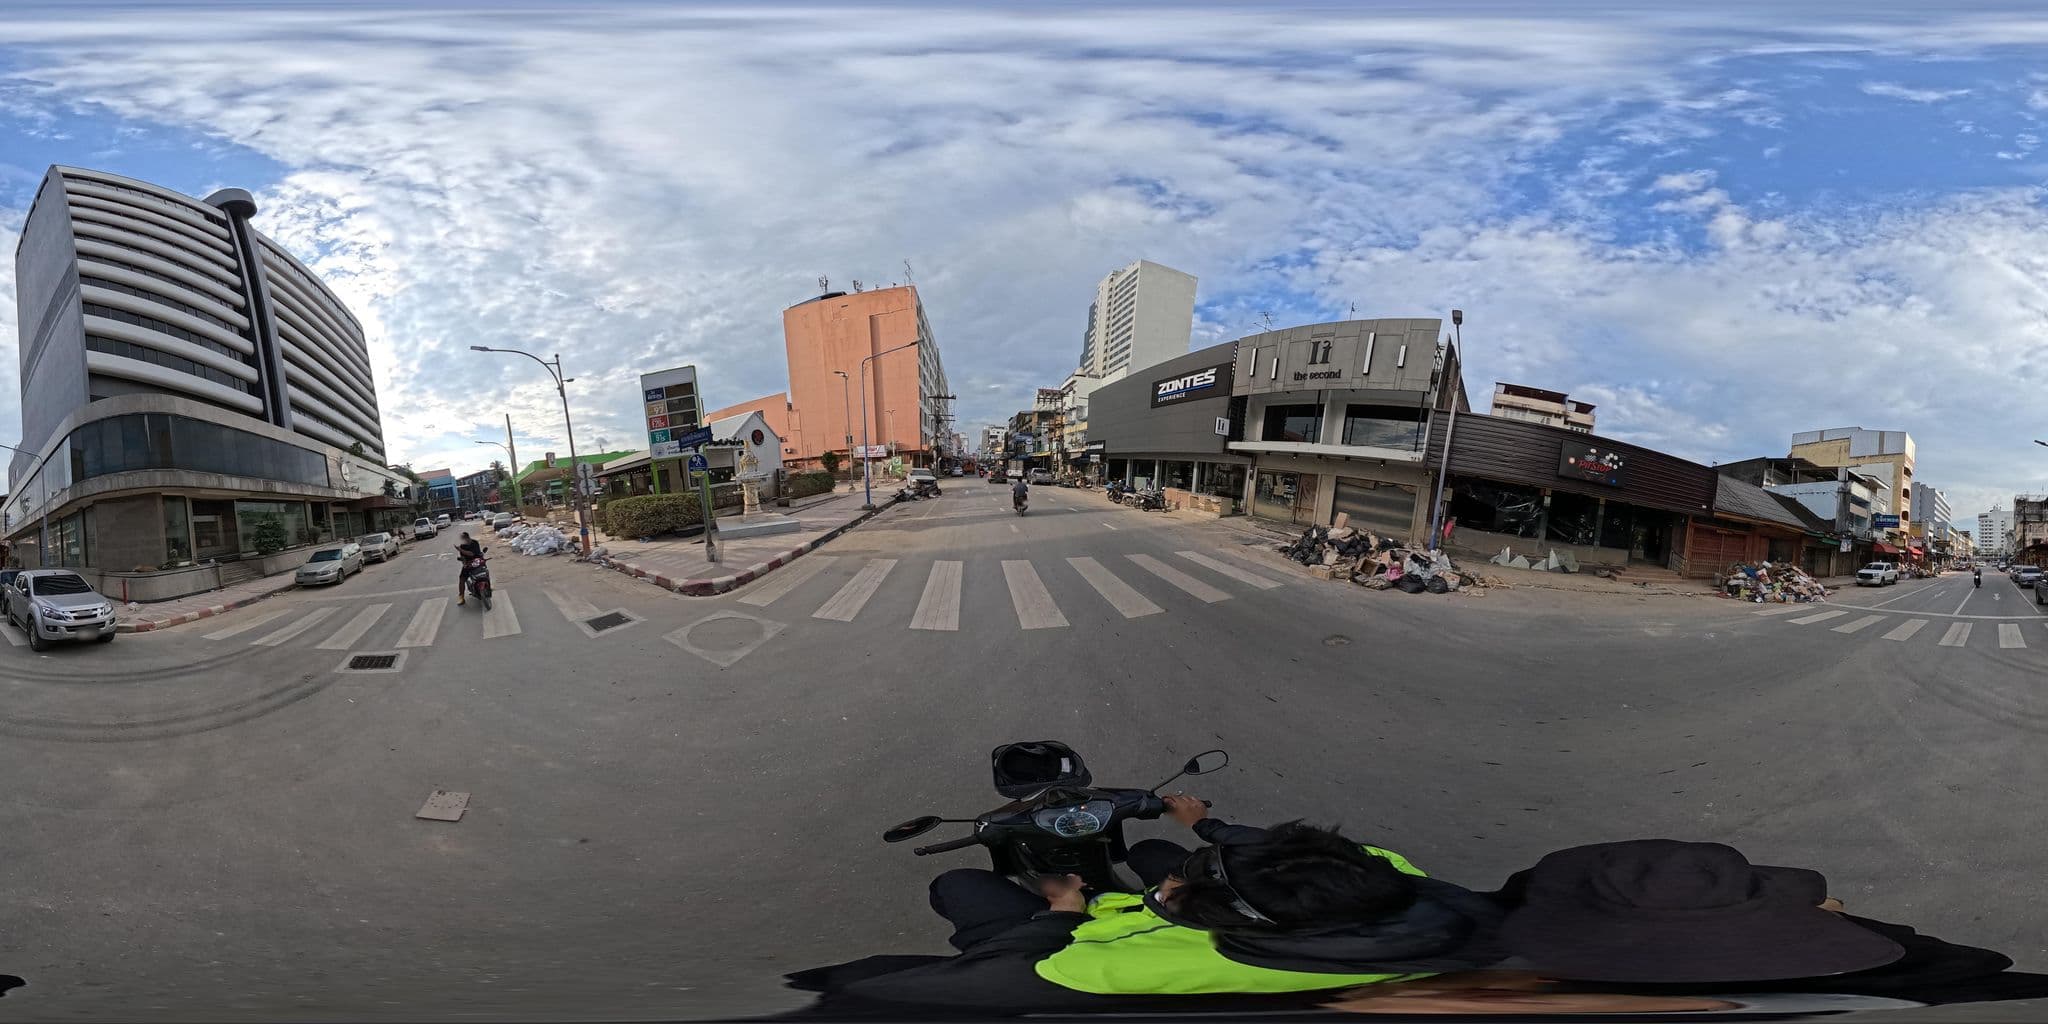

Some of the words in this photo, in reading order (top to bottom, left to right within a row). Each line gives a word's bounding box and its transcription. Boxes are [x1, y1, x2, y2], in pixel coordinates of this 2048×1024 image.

[1293, 371, 1308, 381] the
[1309, 369, 1341, 380] second
[1158, 368, 1217, 395] ZONTES
[1158, 392, 1186, 402] EXPERIENCE
